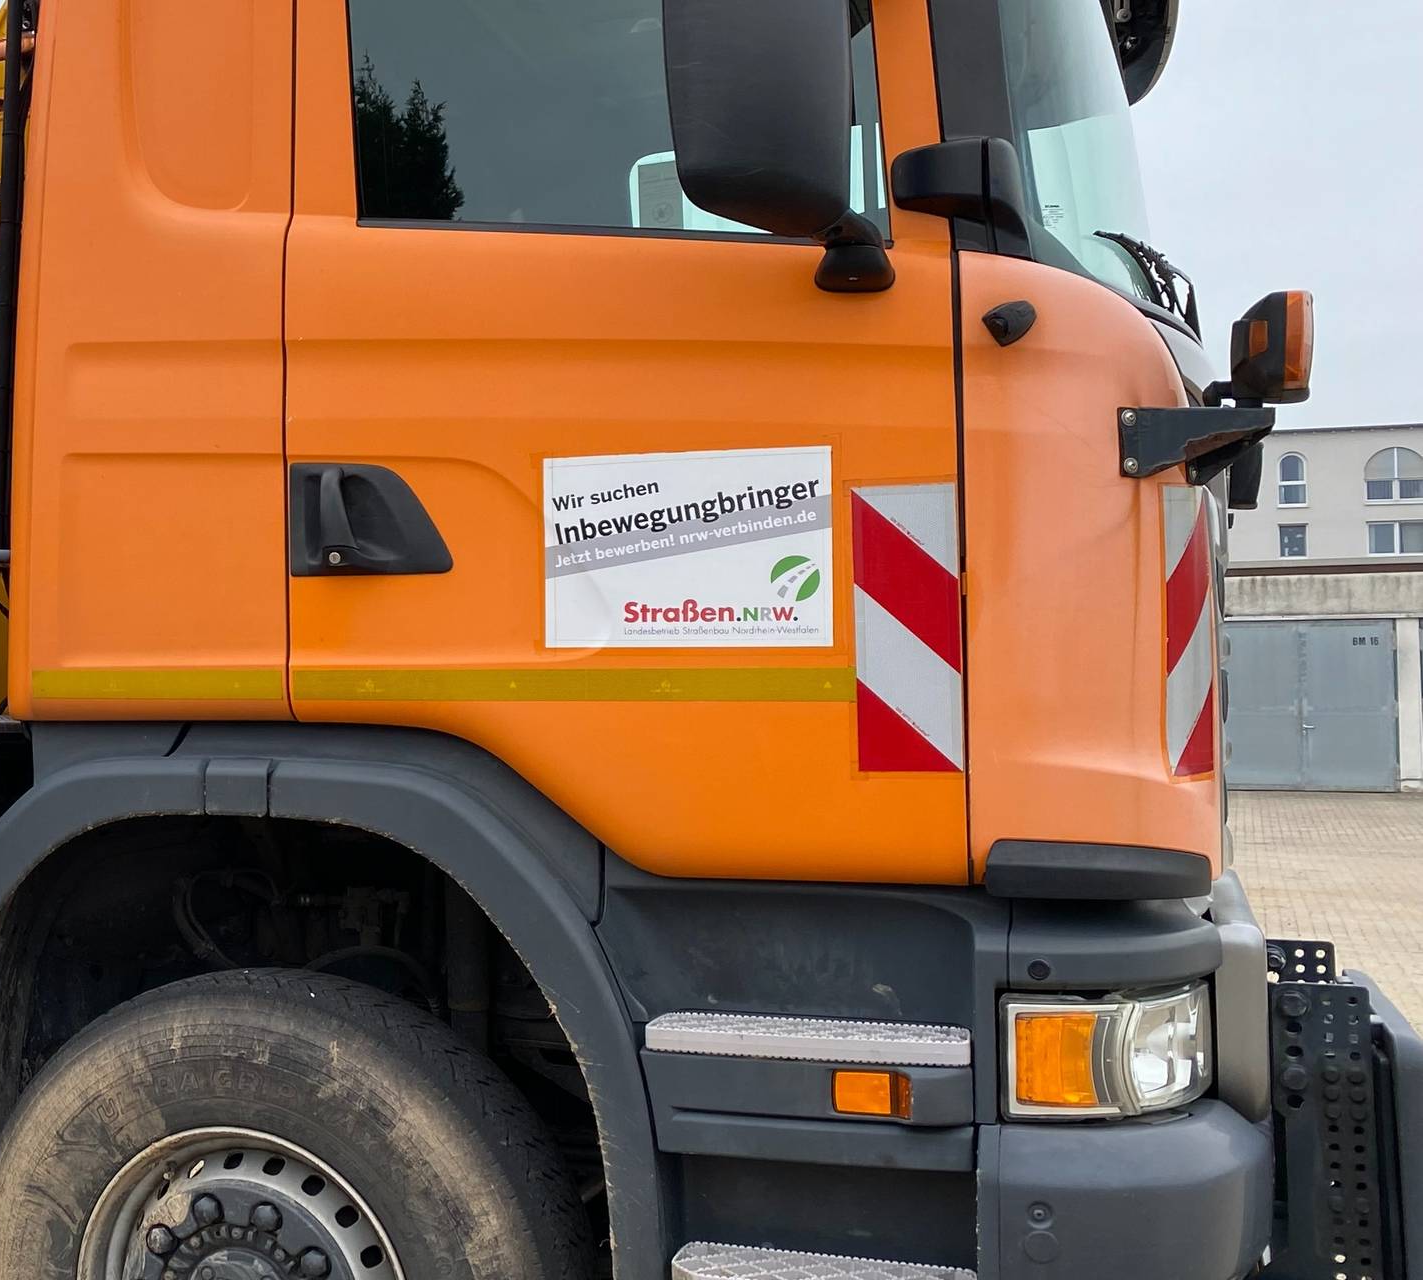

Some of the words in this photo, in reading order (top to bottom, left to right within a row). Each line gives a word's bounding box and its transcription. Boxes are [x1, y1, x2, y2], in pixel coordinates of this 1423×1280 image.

[552, 492, 584, 512] Wir
[590, 481, 659, 505] suchen
[554, 478, 819, 545] Inbewegungbringer
[555, 549, 592, 568] Jetzt
[595, 534, 675, 560] bewerben!
[679, 509, 817, 546] nrw-verbinden.de
[624, 625, 680, 636] Landesbetrieb
[682, 625, 730, 635] Straßenbau
